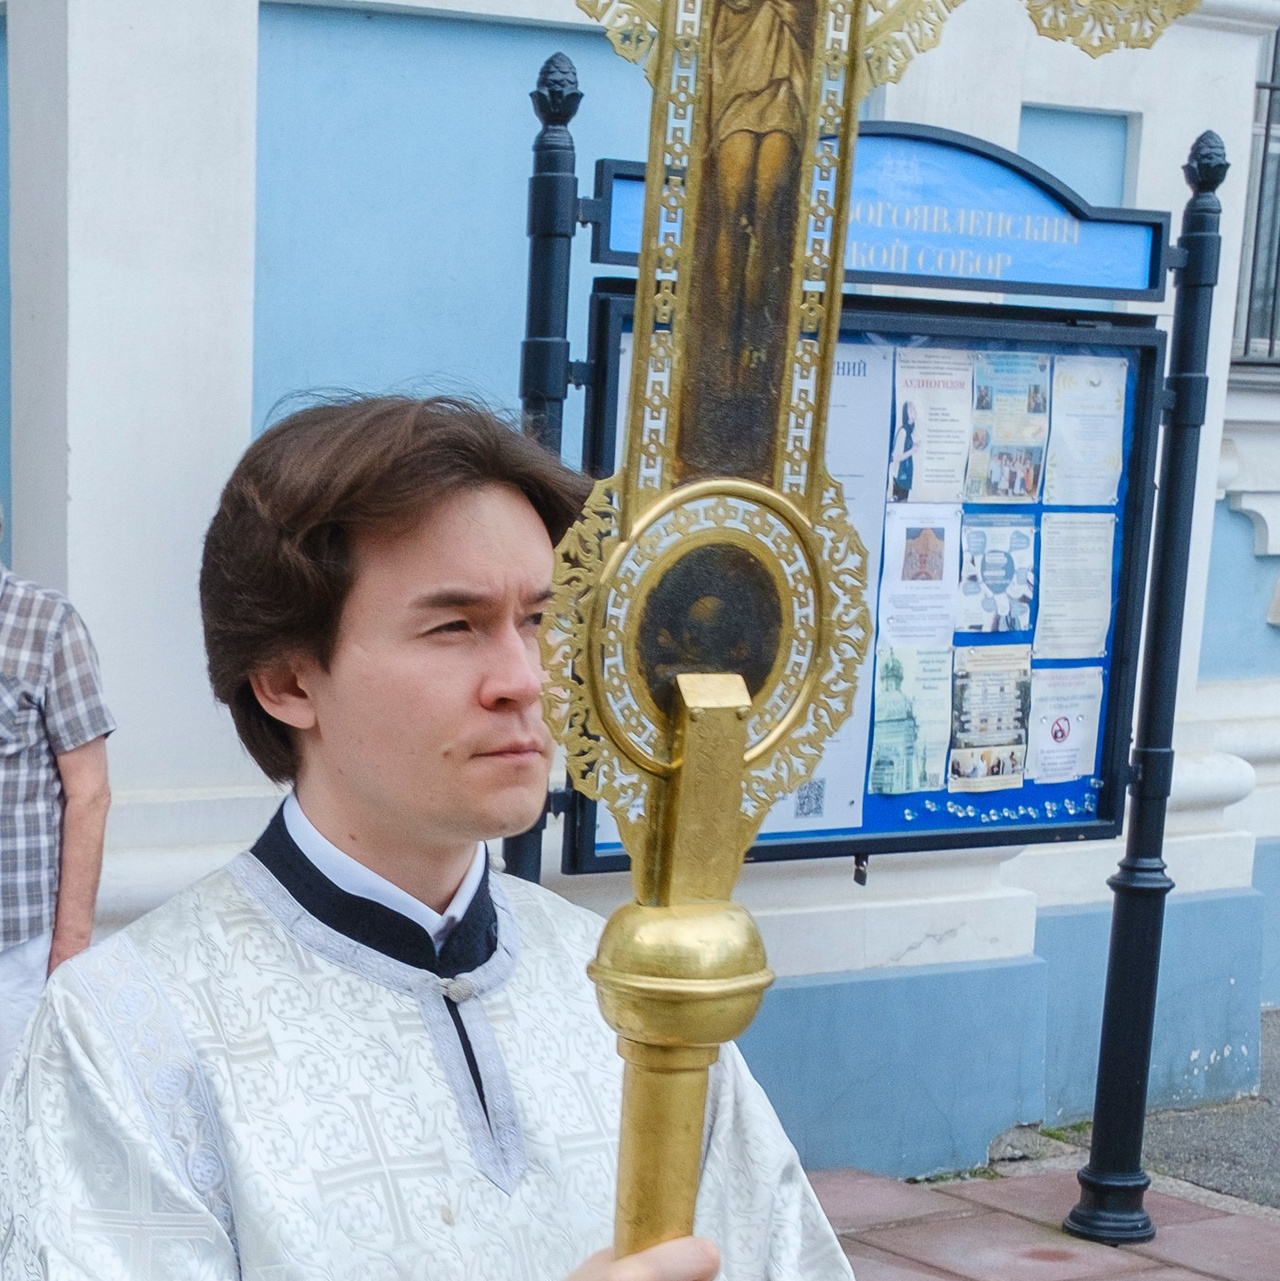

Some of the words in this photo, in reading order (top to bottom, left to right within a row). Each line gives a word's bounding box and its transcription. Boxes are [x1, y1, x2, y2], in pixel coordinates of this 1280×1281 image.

[849, 200, 1080, 244] ОГОЯВЛЕНСКИЙ
[850, 238, 910, 271] КОЙ
[917, 247, 1013, 279] СОБОР
[833, 359, 867, 378] НИЙ
